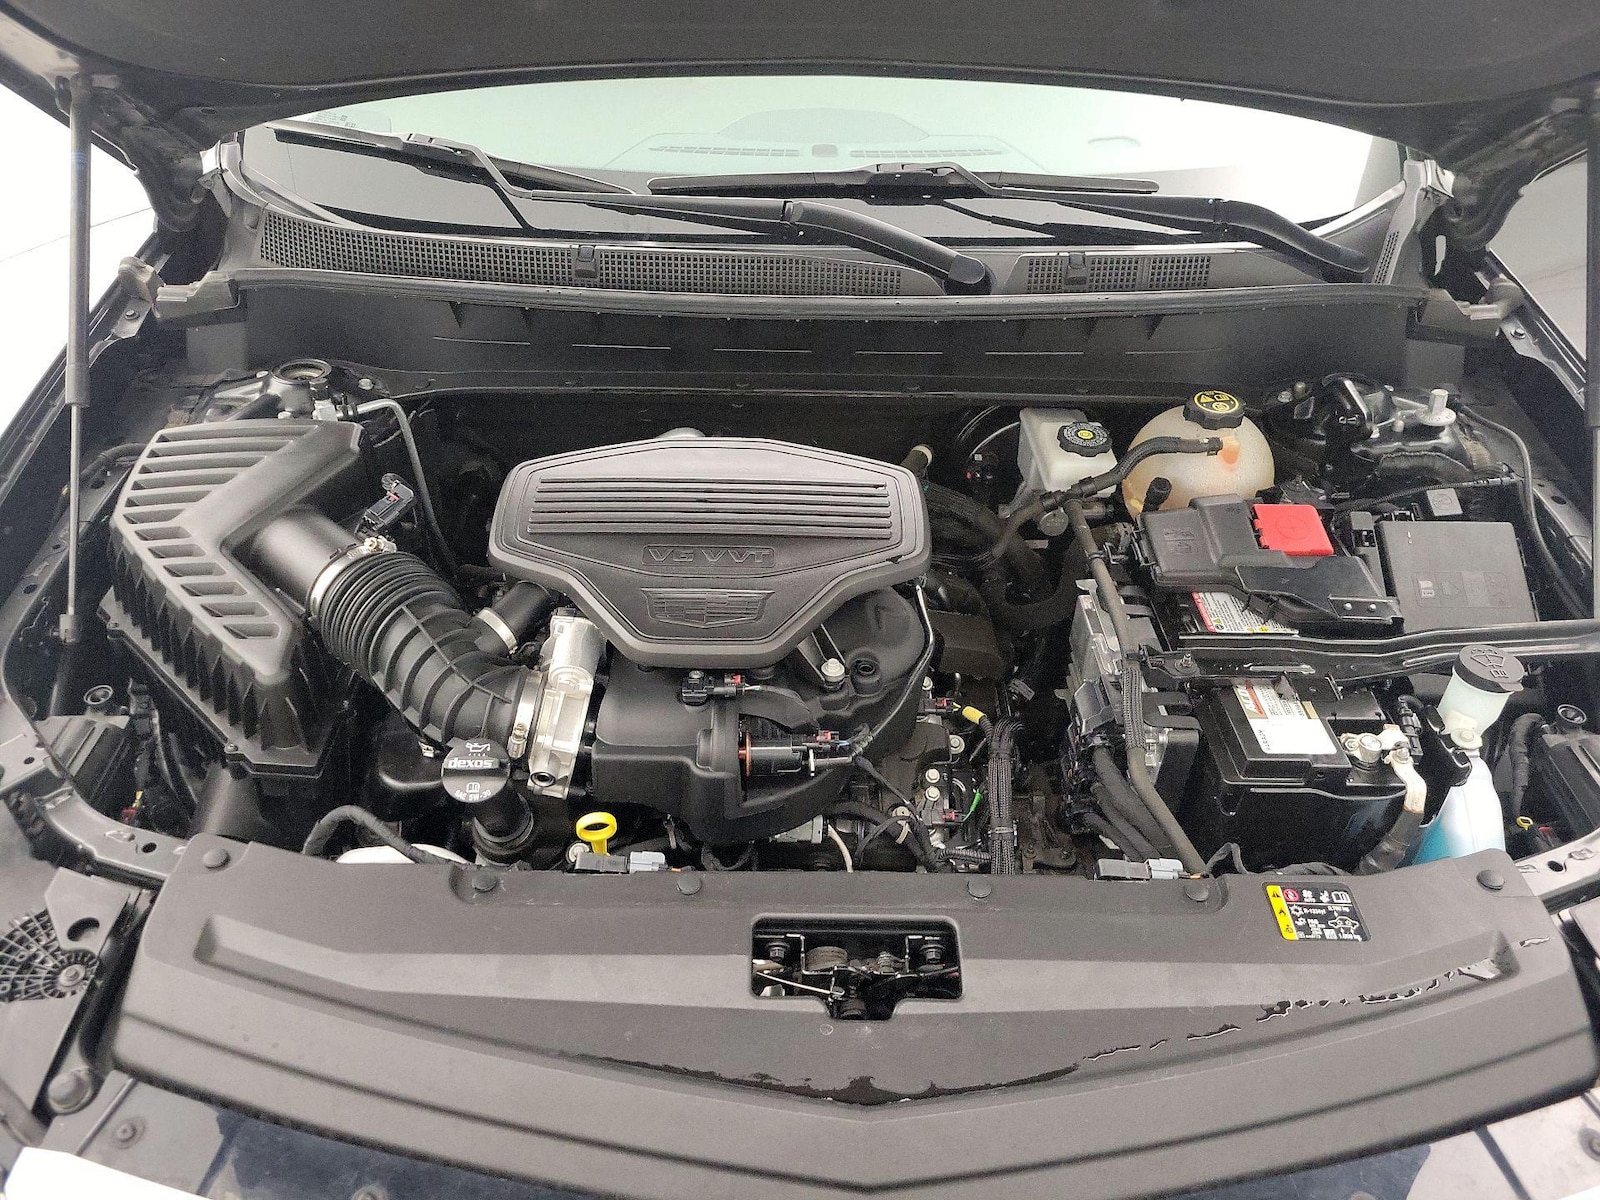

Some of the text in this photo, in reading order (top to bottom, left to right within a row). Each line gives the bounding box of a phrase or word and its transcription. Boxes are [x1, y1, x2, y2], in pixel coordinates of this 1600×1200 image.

[649, 549, 770, 563] V6 VVT
[448, 758, 494, 768] dexos
[454, 789, 492, 801] SAE 5W-30
